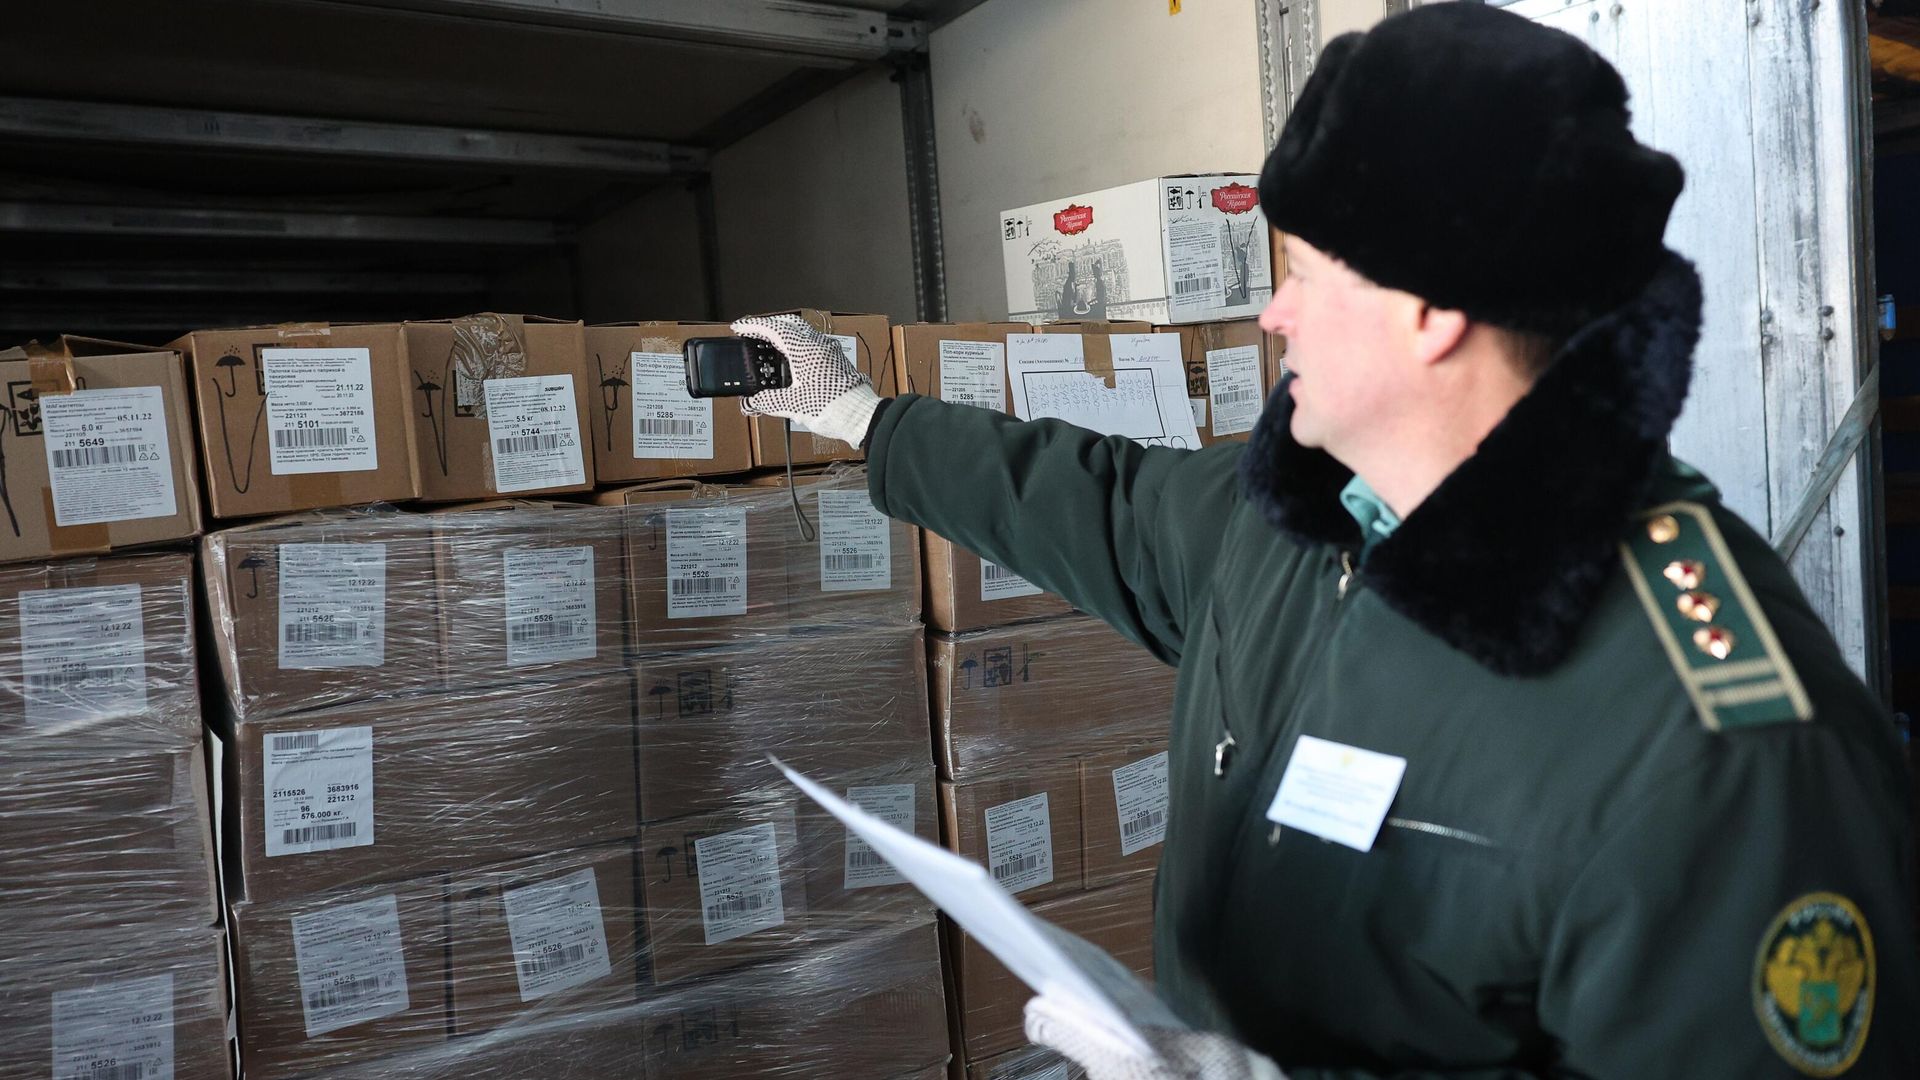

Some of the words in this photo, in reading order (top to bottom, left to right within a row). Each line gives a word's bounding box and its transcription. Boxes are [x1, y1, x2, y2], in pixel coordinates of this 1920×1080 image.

[117, 413, 152, 421] 05.11.22
[298, 420, 319, 428] 5101
[79, 437, 105, 447] 5649
[327, 784, 359, 793] 3683916
[273, 789, 306, 798] 2115526
[328, 794, 355, 803] 221212
[301, 811, 331, 819] 576.000
[1137, 810, 1149, 818] 5526
[1009, 853, 1022, 862] 5526
[543, 943, 562, 954] 5526
[91, 1058, 116, 1070] 5526
